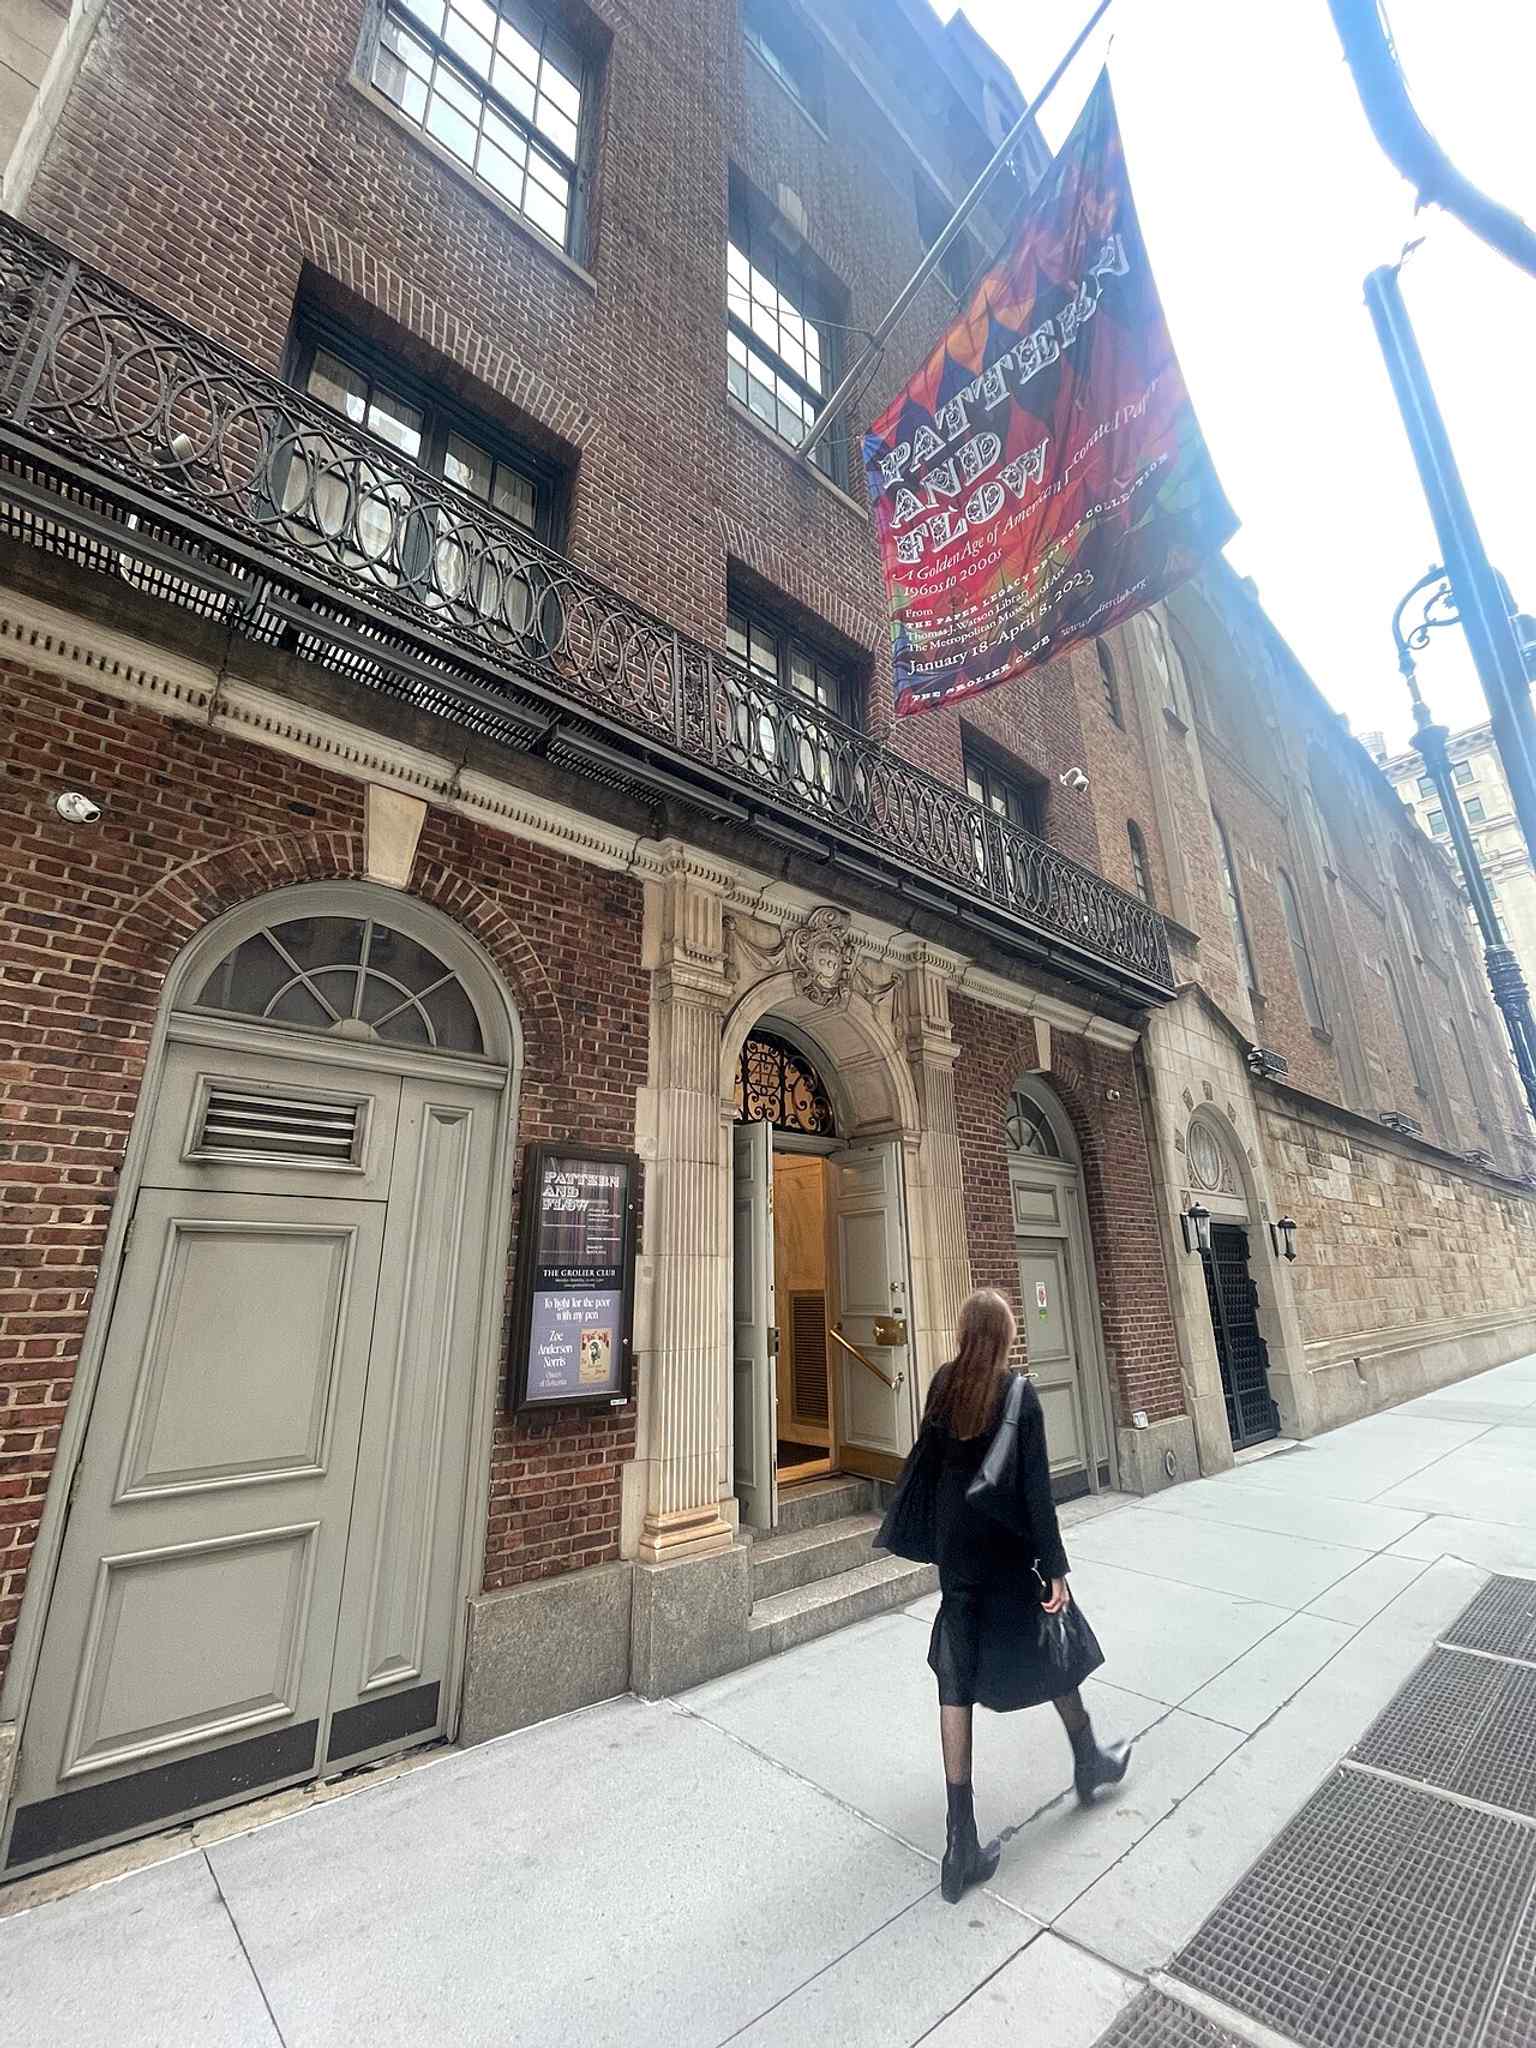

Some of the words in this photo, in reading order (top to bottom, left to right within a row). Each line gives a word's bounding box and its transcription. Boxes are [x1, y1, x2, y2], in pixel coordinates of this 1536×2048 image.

[877, 232, 1131, 489] PATTERN
[890, 432, 1001, 529] AND
[893, 437, 1049, 563] FLOW
[917, 552, 961, 580] Golden
[960, 540, 985, 558] Age
[986, 521, 1000, 547] of
[1002, 480, 1061, 534] American
[904, 583, 944, 599] 1960s
[944, 576, 957, 590] to
[959, 547, 1002, 582] 2000s
[905, 607, 934, 619] From
[906, 618, 933, 630] THE
[937, 603, 979, 625] PAPER
[982, 572, 1030, 608] LEGACY
[907, 642, 928, 653] The
[929, 618, 997, 651] Metropolitan
[998, 593, 1038, 625] Museum
[1039, 577, 1050, 594] of
[1050, 566, 1065, 586] Art
[906, 625, 948, 642] Thomas
[956, 610, 994, 631] Watson
[907, 649, 969, 676] January
[1039, 599, 1052, 616] 8,
[1054, 568, 1095, 602] 2023
[911, 690, 941, 702] THE
[1015, 634, 1051, 664] CLUB
[542, 1184, 579, 1198] AND
[544, 1170, 619, 1188] PATTERN
[542, 1198, 589, 1212] FLOW
[544, 1269, 559, 1277] THE
[560, 1269, 595, 1277] GROLIER
[596, 1269, 616, 1277] CLUB
[571, 1297, 582, 1308] for
[583, 1297, 594, 1308] the
[595, 1298, 611, 1310] poor
[573, 1311, 584, 1323] my
[584, 1311, 599, 1323] pen
[537, 1343, 573, 1355] Anderson
[543, 1356, 567, 1368] Norris
